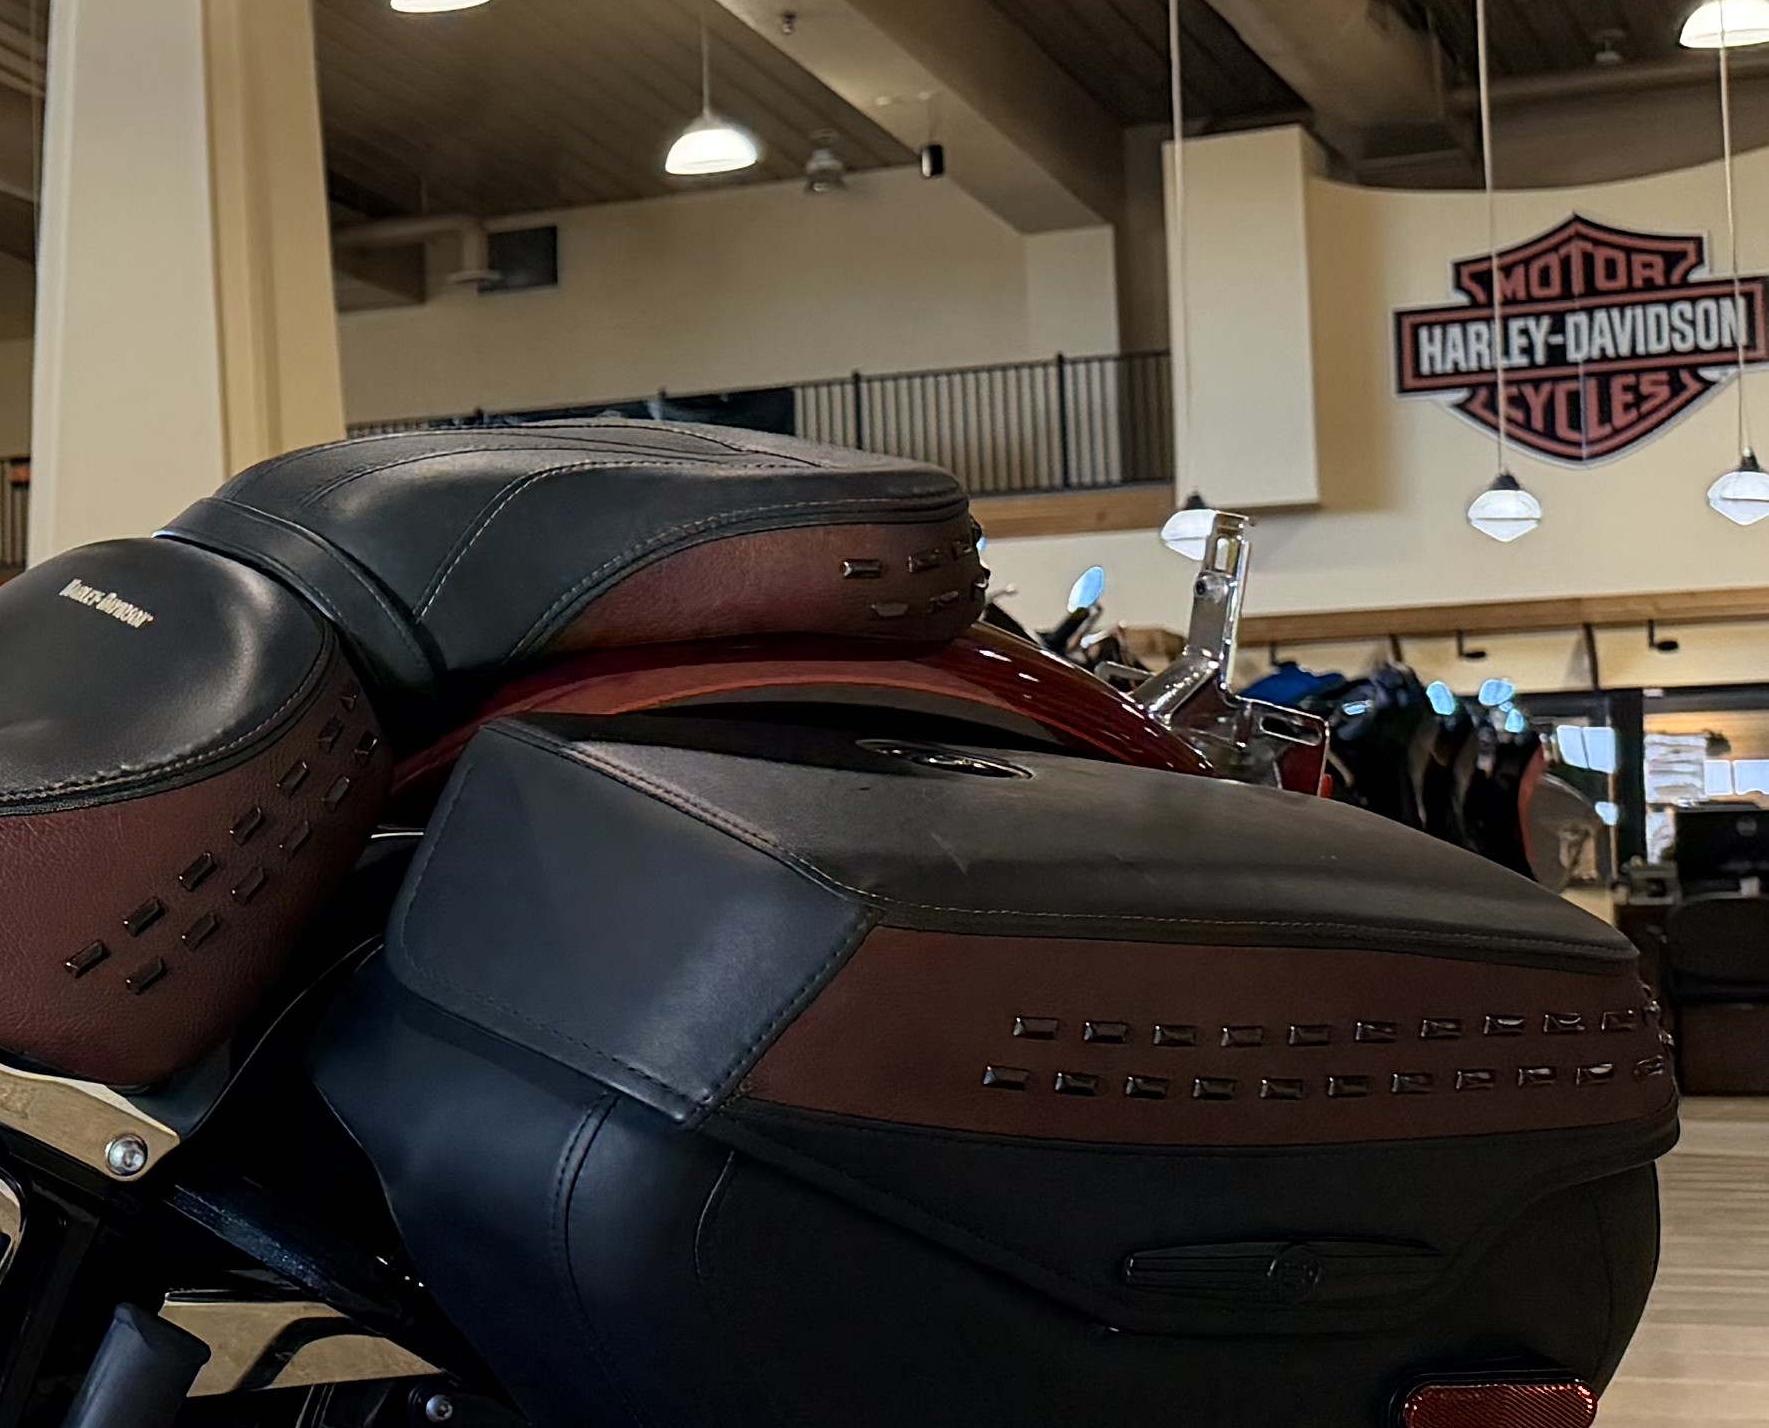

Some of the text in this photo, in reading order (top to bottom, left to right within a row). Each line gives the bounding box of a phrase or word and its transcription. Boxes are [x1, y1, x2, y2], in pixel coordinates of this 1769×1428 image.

[1498, 238, 1666, 302] MOTOR
[1417, 295, 1749, 376] HARLEY-DAVIDSON
[1500, 373, 1673, 442] CYCLES
